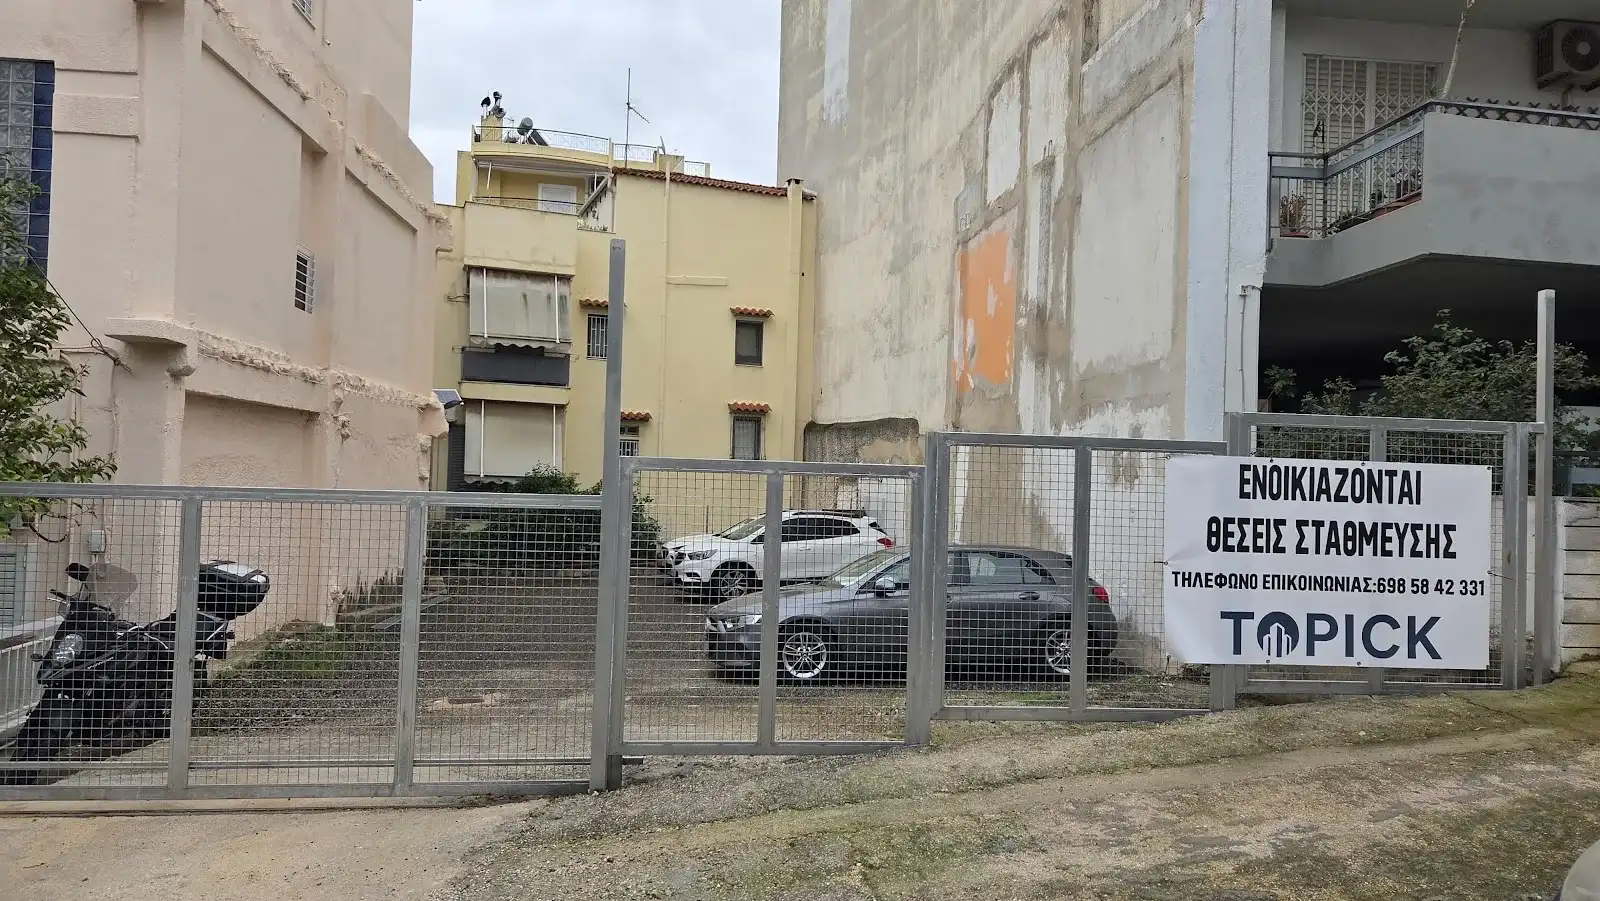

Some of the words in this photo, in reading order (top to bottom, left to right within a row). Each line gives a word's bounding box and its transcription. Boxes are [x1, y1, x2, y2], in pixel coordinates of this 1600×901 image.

[1238, 463, 1422, 506] ΕΝΟΙΚΙΑΖΟΝΤΑΙ
[1206, 515, 1287, 555] ΘΕΣΕΙΣ
[1295, 519, 1457, 560] ΣΤΑΘΜΕΥΣΗΣ
[1171, 570, 1258, 590] ΤΗΛΕΦΩΝΟ
[1410, 578, 1430, 595] 58
[1433, 578, 1455, 596] 42
[1459, 579, 1485, 596] 331
[1219, 610, 1443, 660] TOPICK
